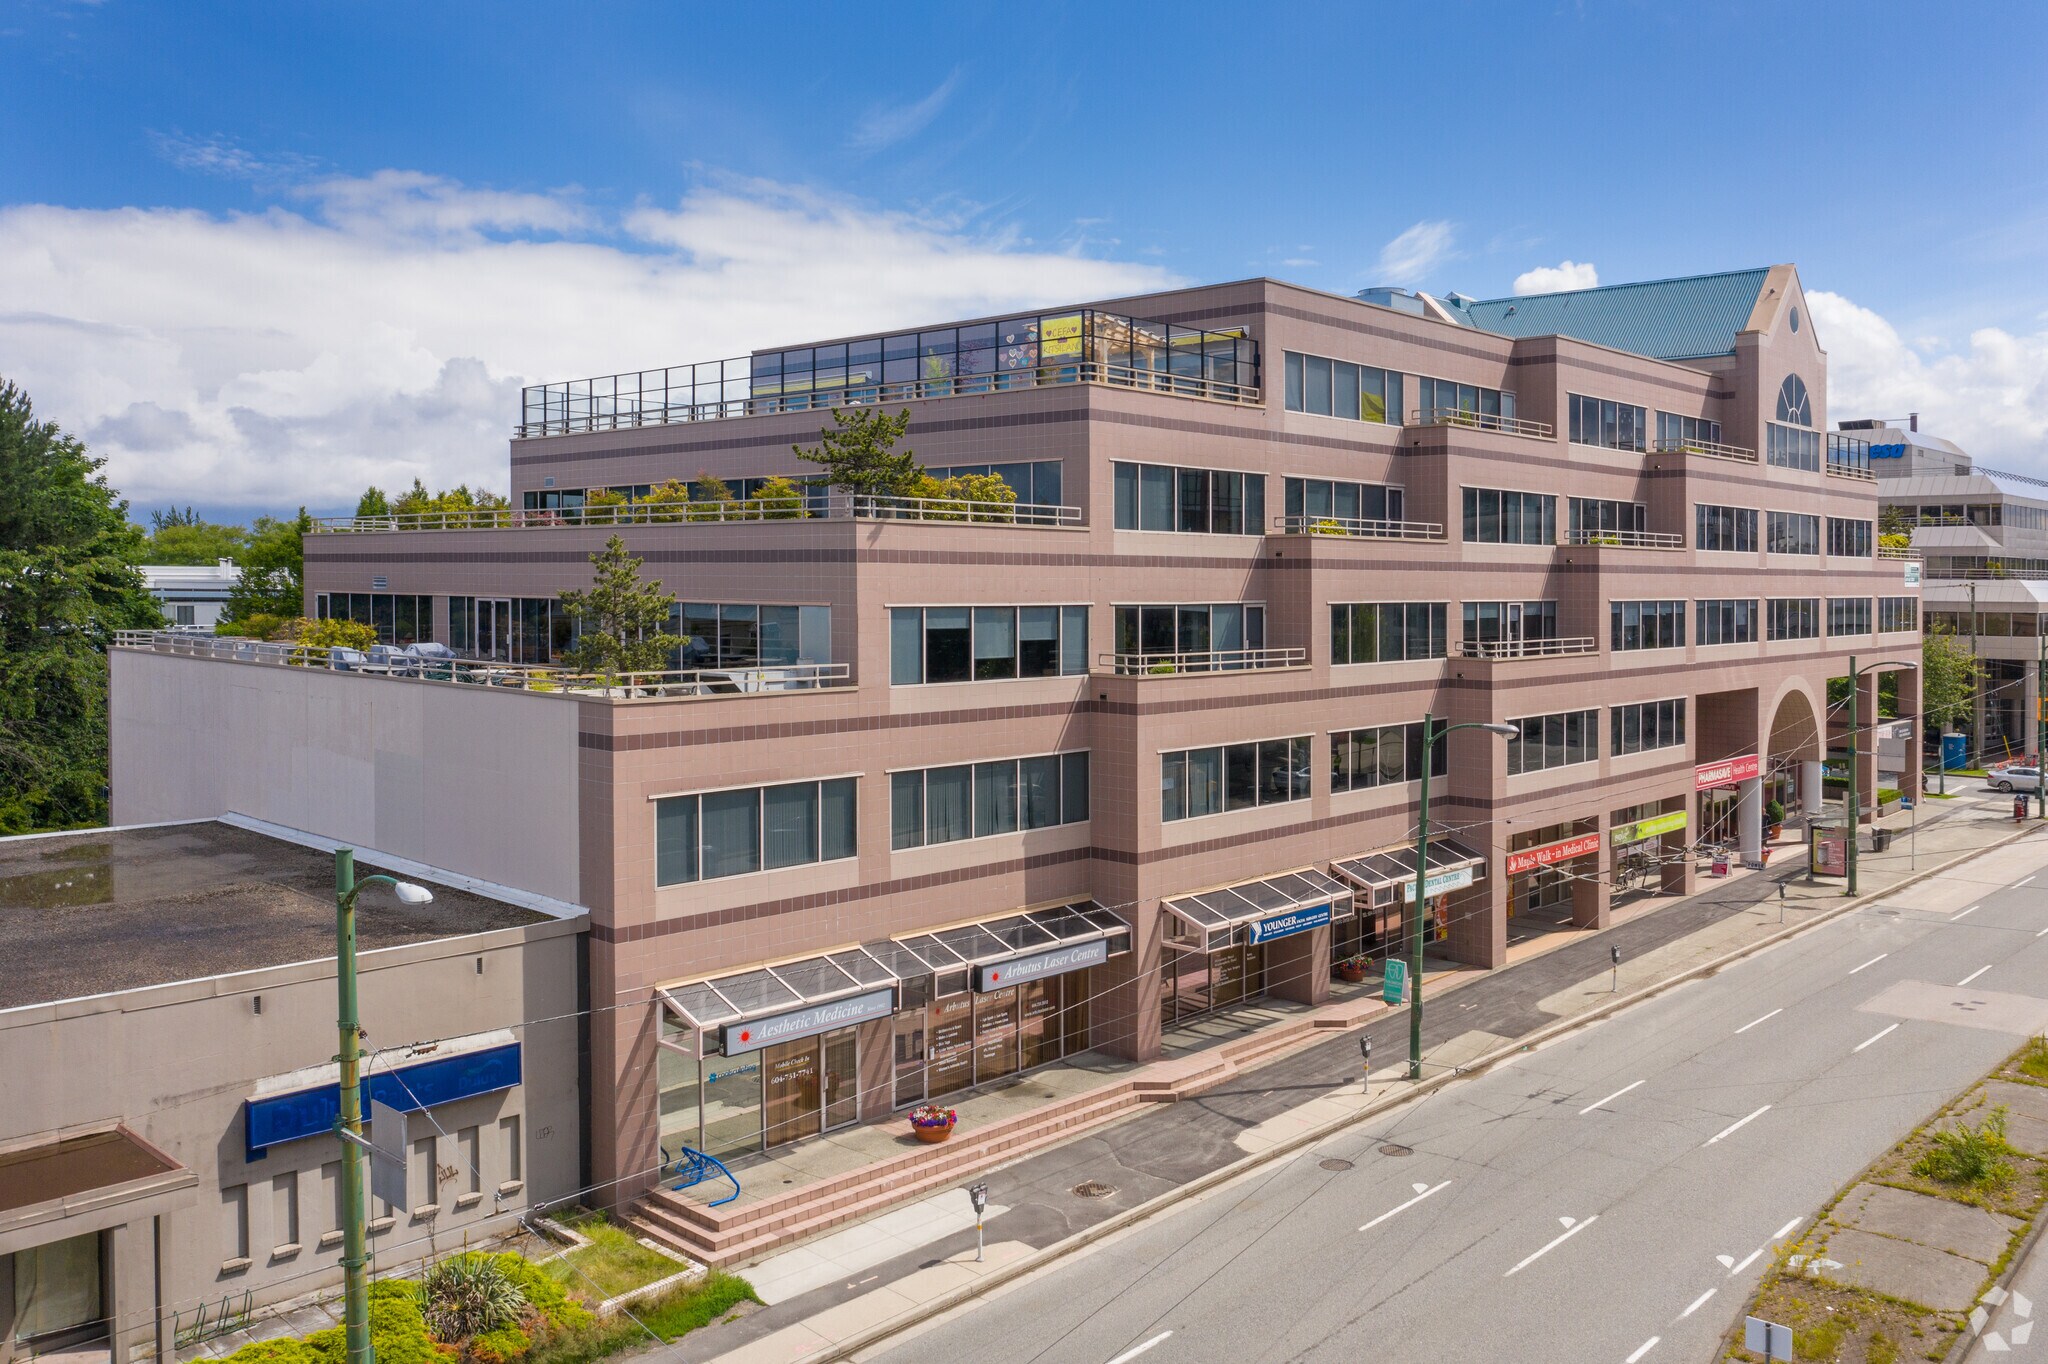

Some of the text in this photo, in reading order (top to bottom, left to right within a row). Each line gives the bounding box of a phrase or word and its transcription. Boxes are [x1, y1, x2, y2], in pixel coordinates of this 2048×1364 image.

[1052, 327, 1072, 337] CEFA
[1698, 767, 1731, 784] PHARMASAVE
[1733, 762, 1758, 775] Health Centre
[1537, 850, 1551, 864] Walk
[1562, 841, 1583, 857] Medical
[1583, 838, 1599, 851] Clinic
[1425, 877, 1442, 888] DENTAL
[1442, 872, 1460, 884] CENTRE
[1263, 915, 1297, 933] YOUNGER
[1004, 948, 1099, 980] Arbutus Laser Centre
[943, 988, 1015, 1013] Arbutus Laser Centre
[757, 1003, 864, 1040] Aesthetic Medicine
